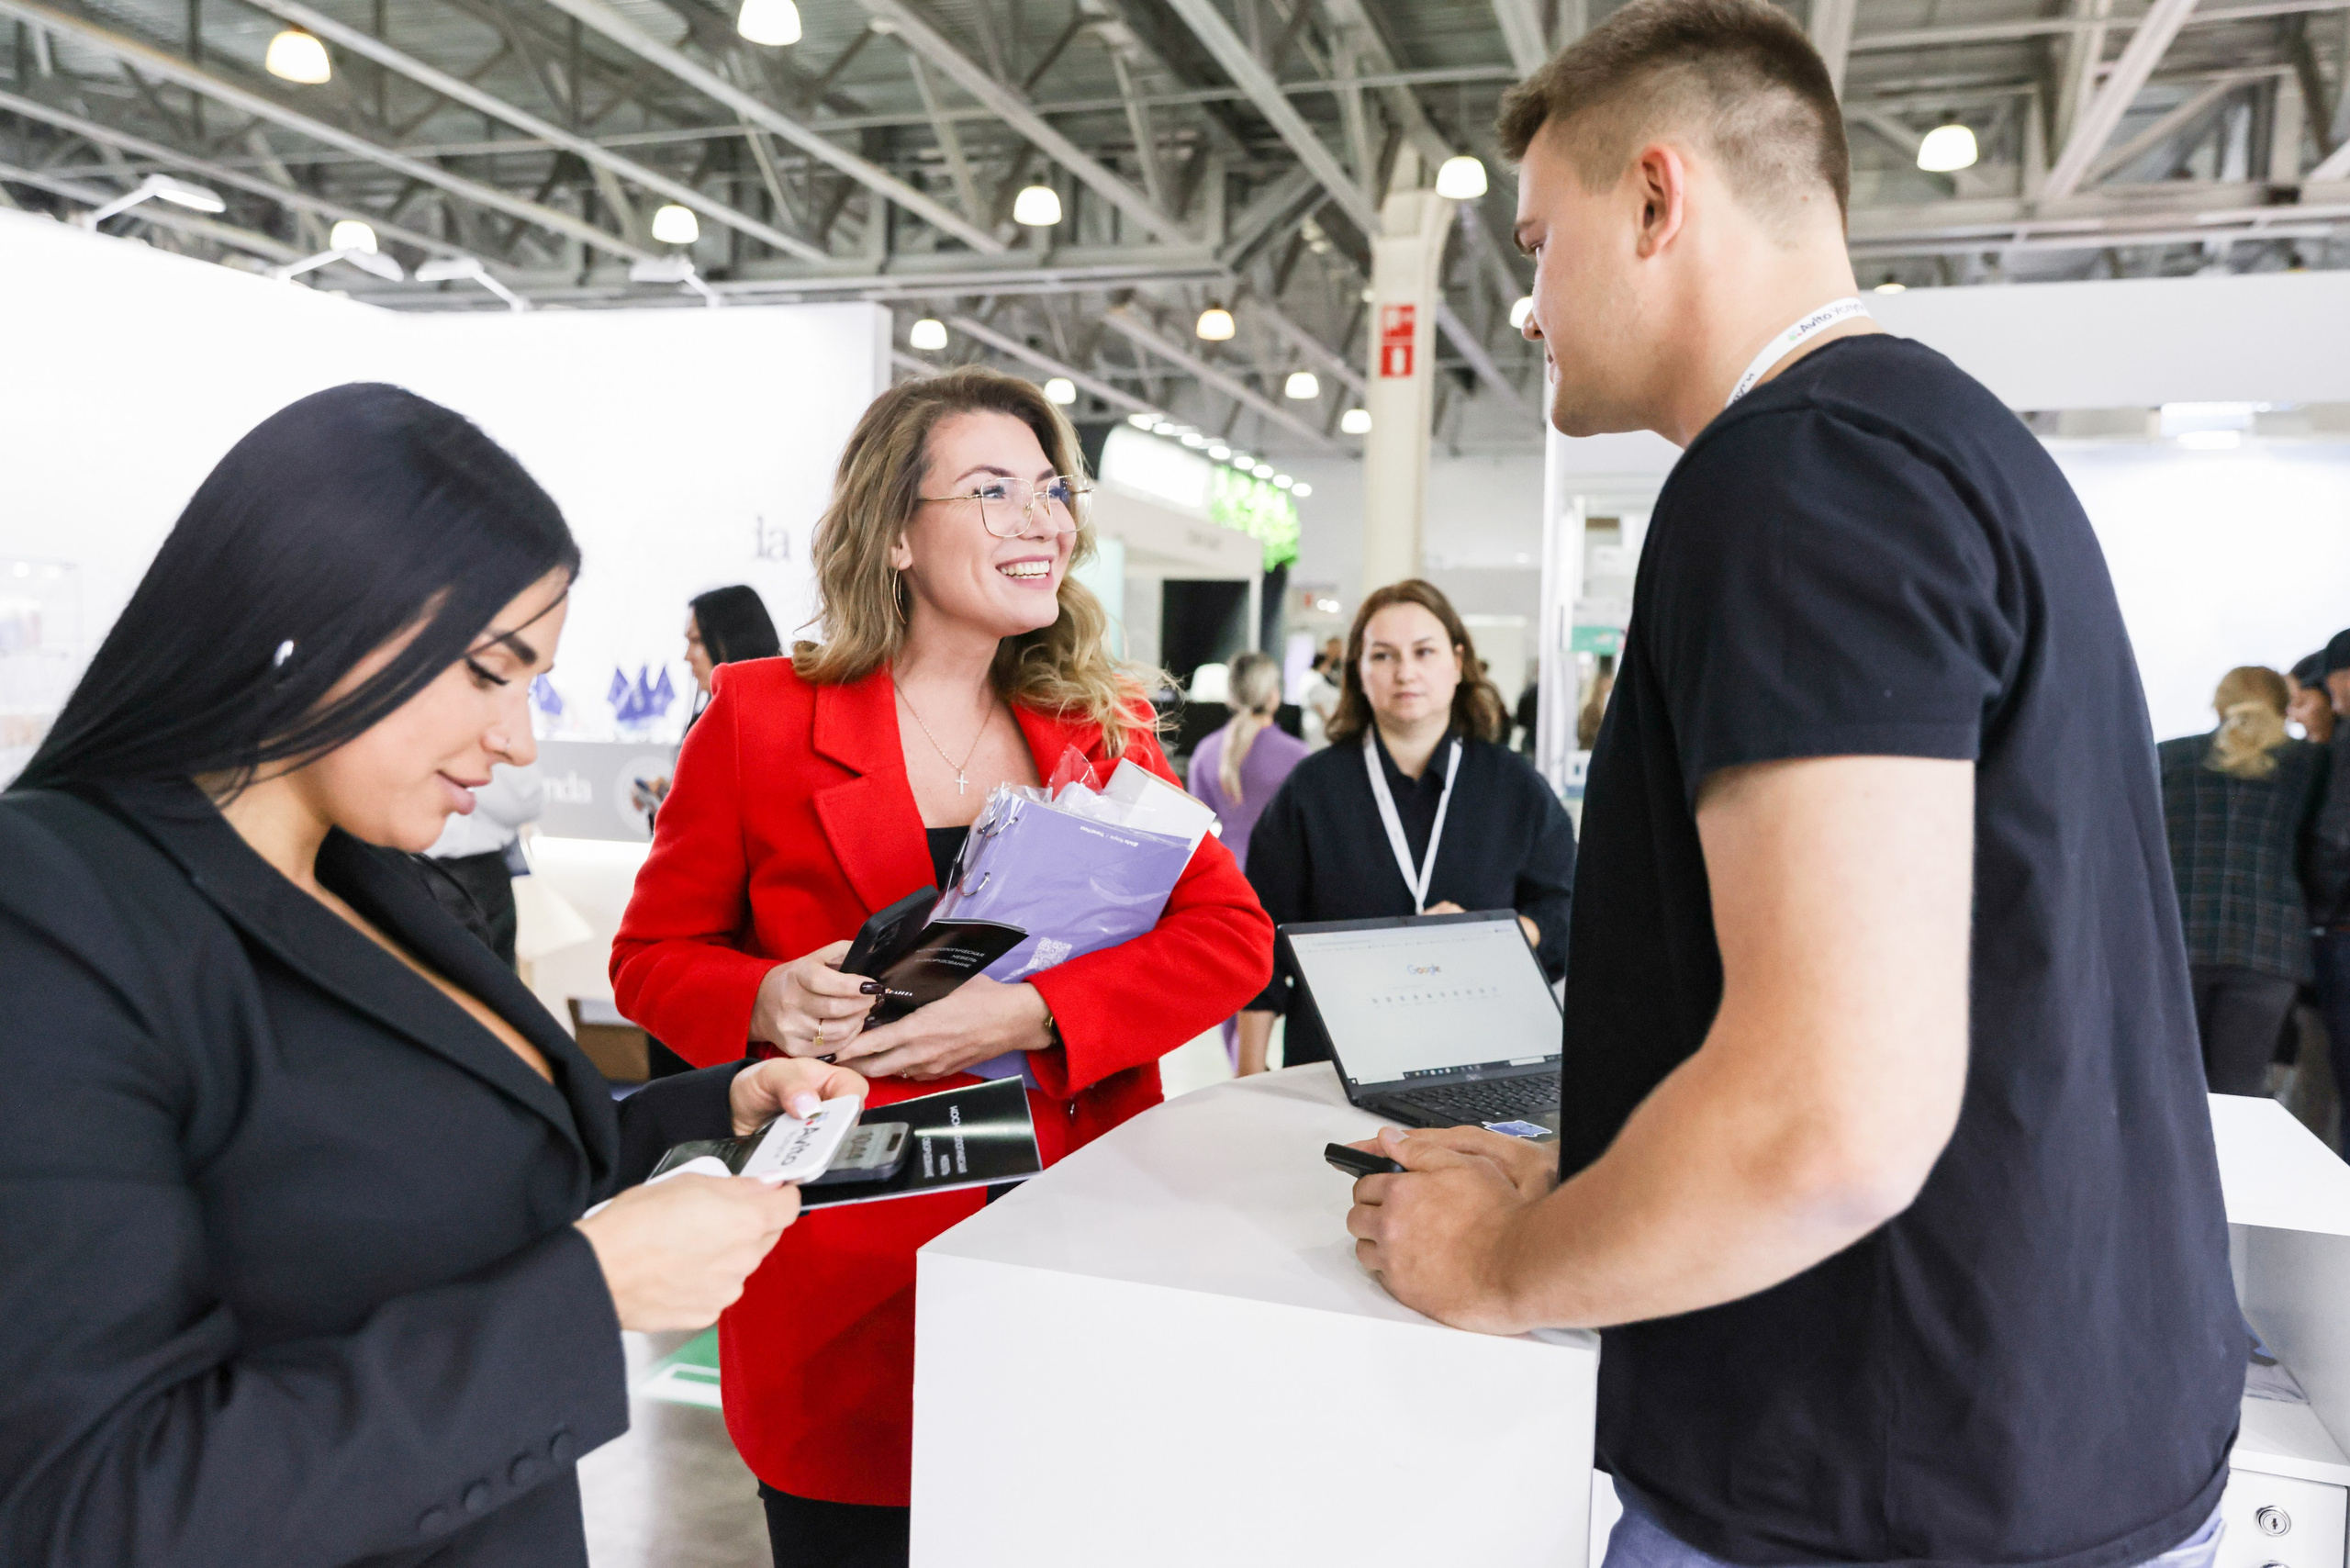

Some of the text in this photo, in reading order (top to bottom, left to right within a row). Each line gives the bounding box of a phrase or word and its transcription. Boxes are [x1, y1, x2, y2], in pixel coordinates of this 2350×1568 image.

[1800, 313, 1832, 333] Avito
[952, 954, 978, 963] МЕБЕЛЬ
[1407, 964, 1441, 976] Google
[781, 1126, 822, 1166] Avito
